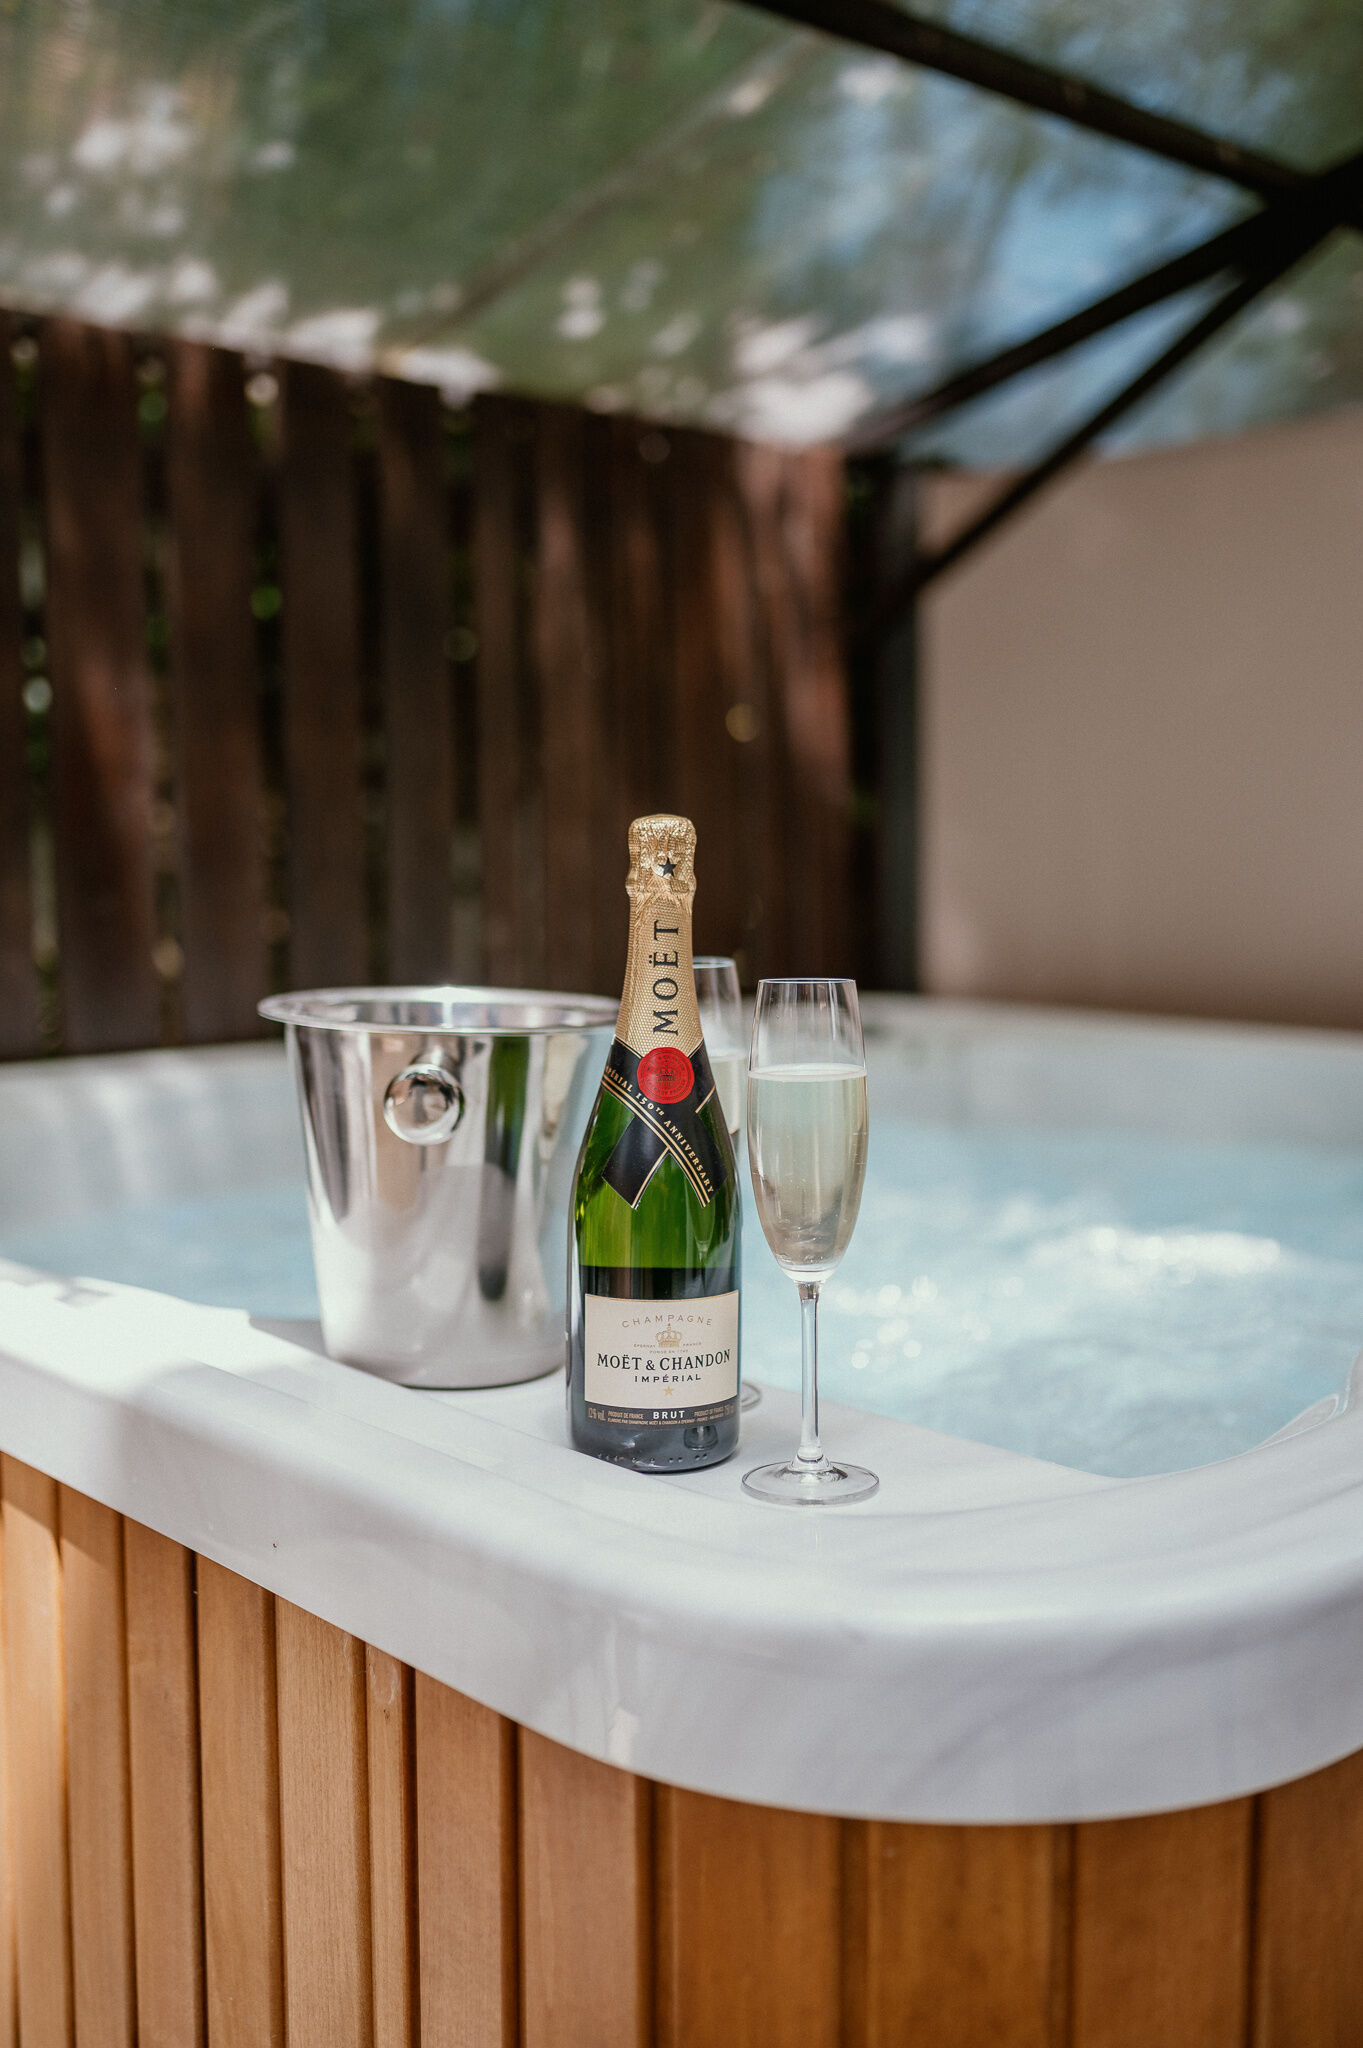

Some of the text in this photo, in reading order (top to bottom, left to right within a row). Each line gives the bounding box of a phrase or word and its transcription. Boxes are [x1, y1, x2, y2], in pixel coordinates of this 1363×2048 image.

[649, 920, 679, 1036] MOËT
[663, 1120, 715, 1194] ANNIVERSARY
[622, 1314, 713, 1328] CHAMPAGNE
[597, 1349, 731, 1371] MOËT & CHANDON
[634, 1373, 702, 1383] IMPÉRIAL
[653, 1410, 685, 1420] BRUT
